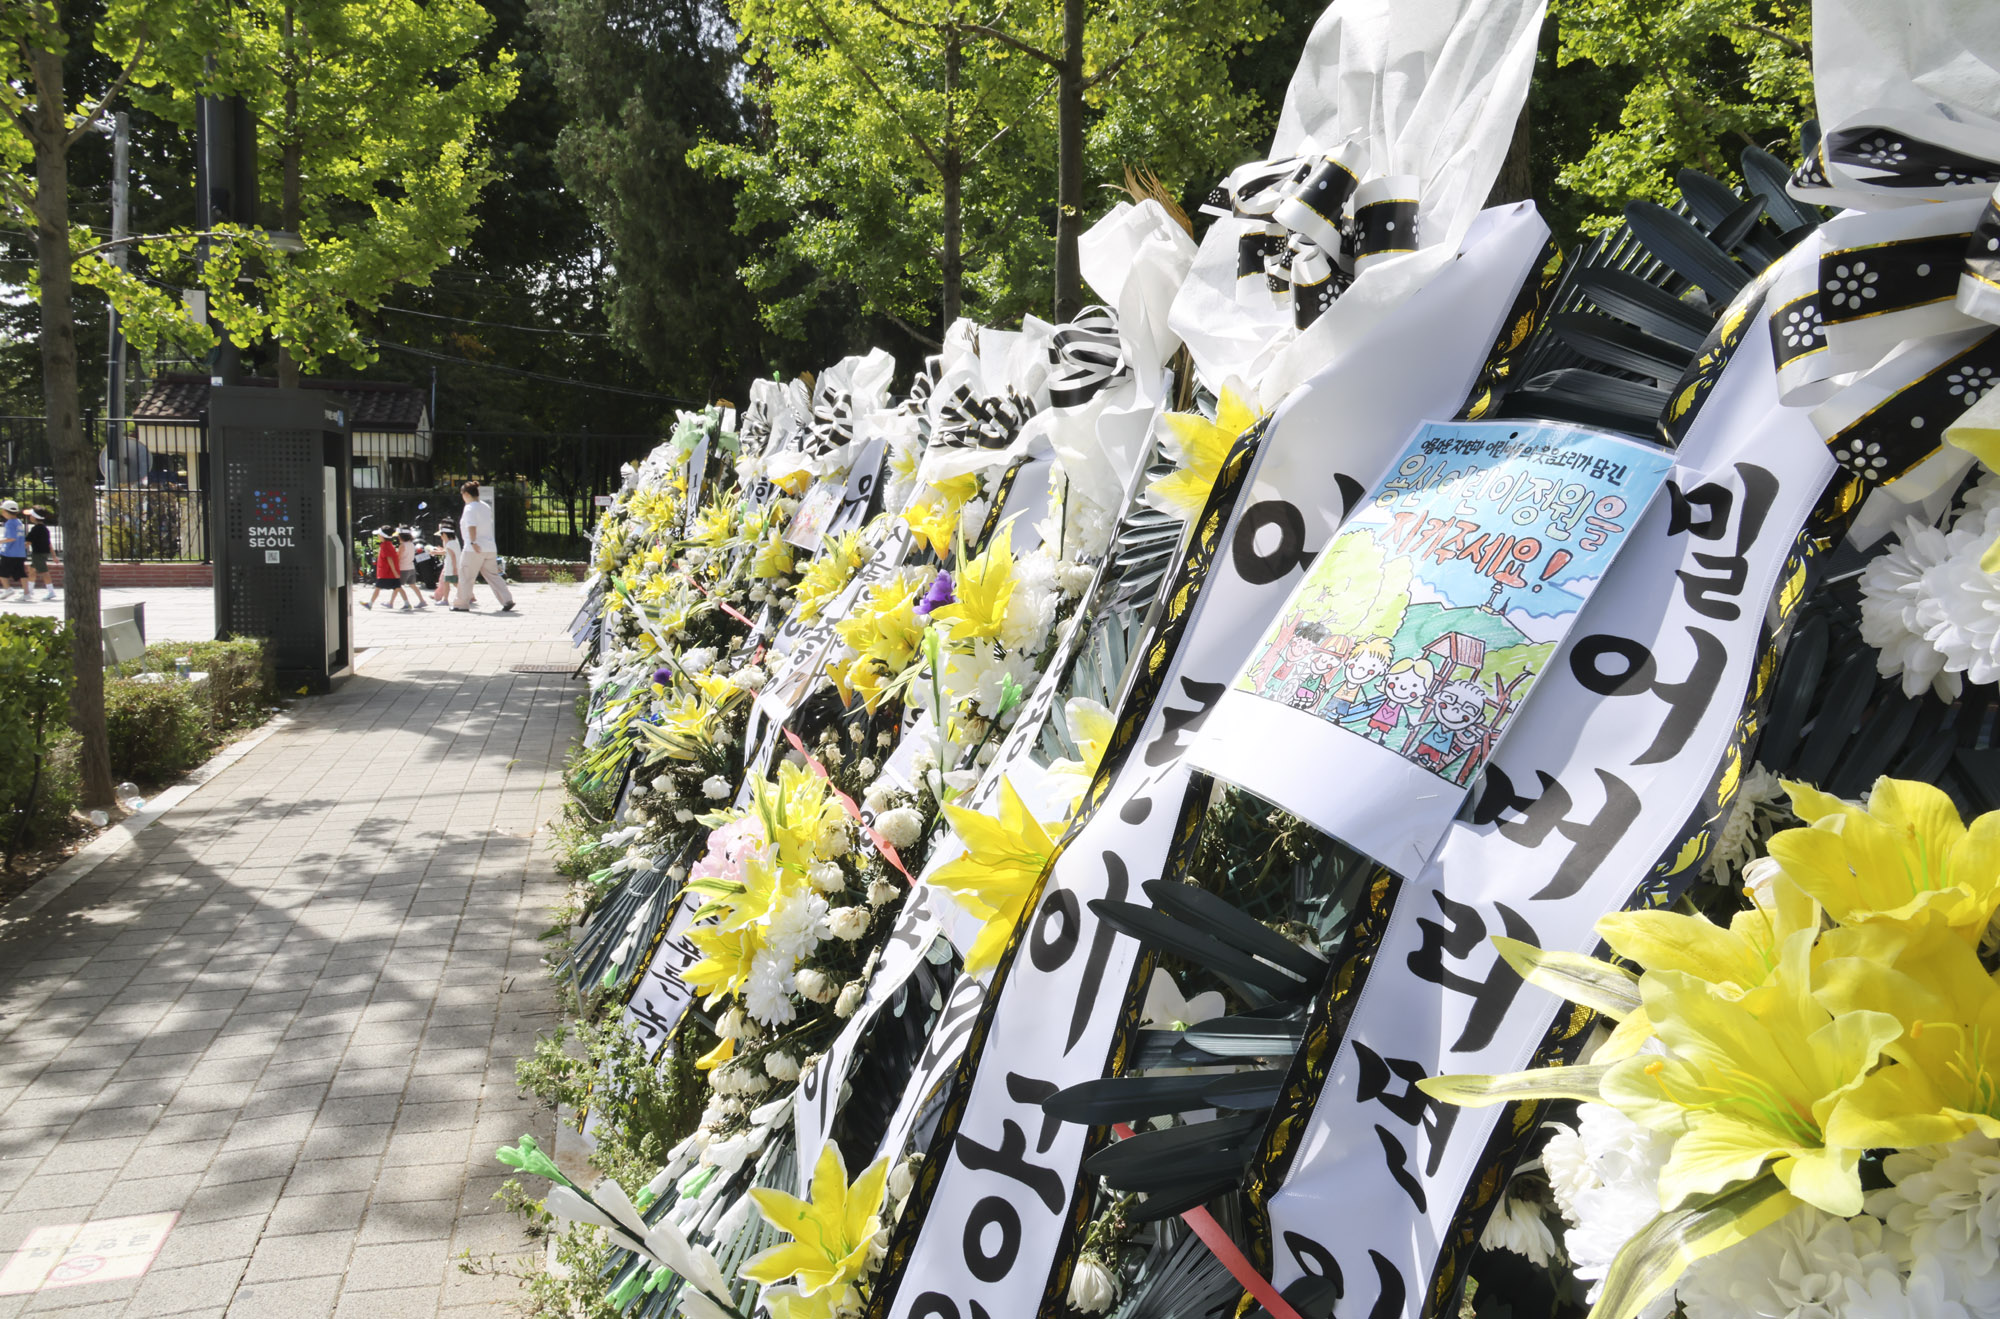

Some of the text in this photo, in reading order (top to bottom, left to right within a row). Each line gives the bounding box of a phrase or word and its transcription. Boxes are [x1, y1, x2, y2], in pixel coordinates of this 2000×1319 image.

[1589, 458, 1628, 487] 담긴
[1375, 454, 1628, 552] 용산어린이정원을
[248, 526, 294, 536] SMART
[249, 537, 295, 547] SEOUL
